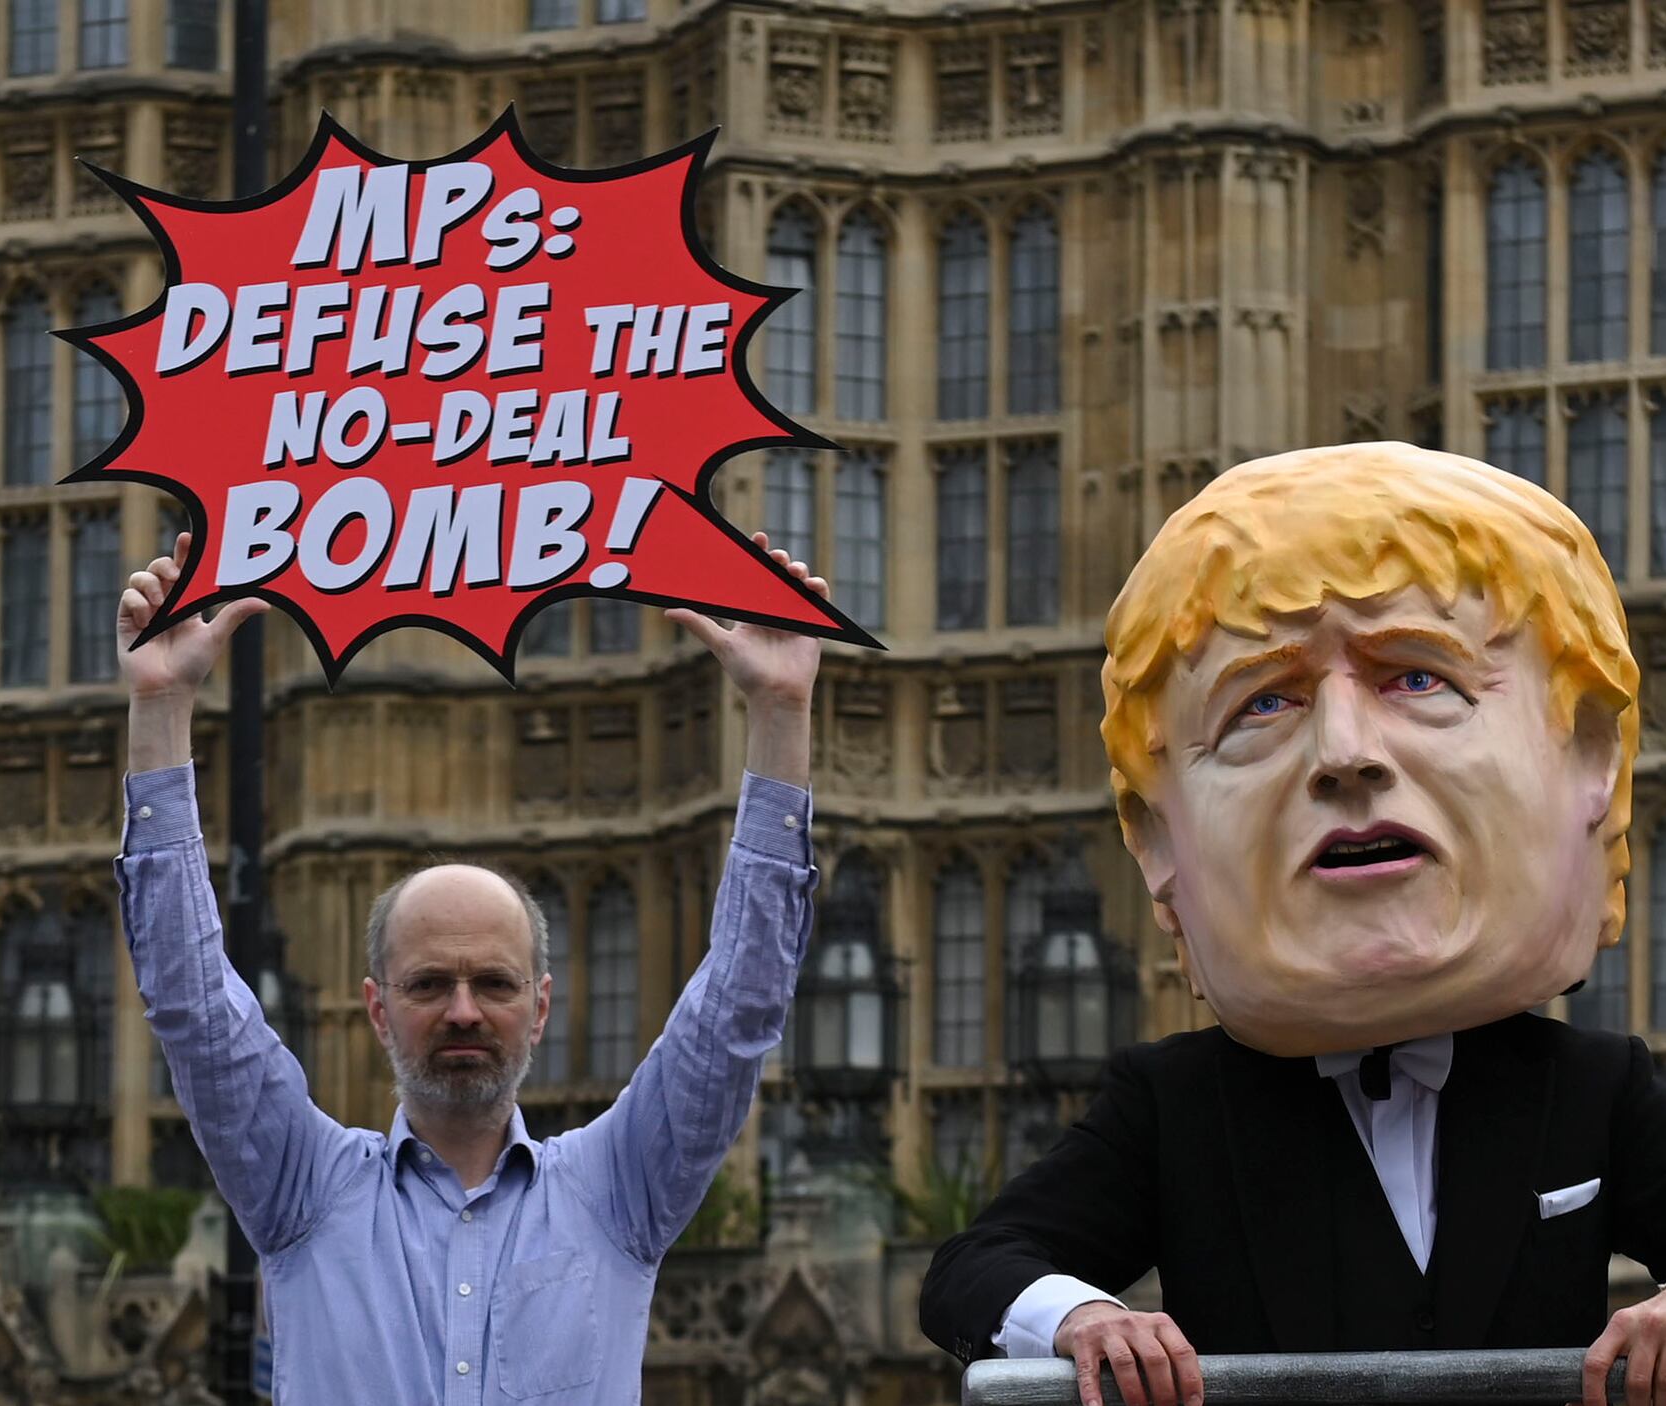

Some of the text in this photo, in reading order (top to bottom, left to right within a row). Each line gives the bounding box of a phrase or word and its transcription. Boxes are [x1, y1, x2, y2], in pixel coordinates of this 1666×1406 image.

[155, 281, 731, 377] DEFUSE THE
[263, 386, 630, 466] NO-DEAL
[214, 475, 663, 593] BOMB!
